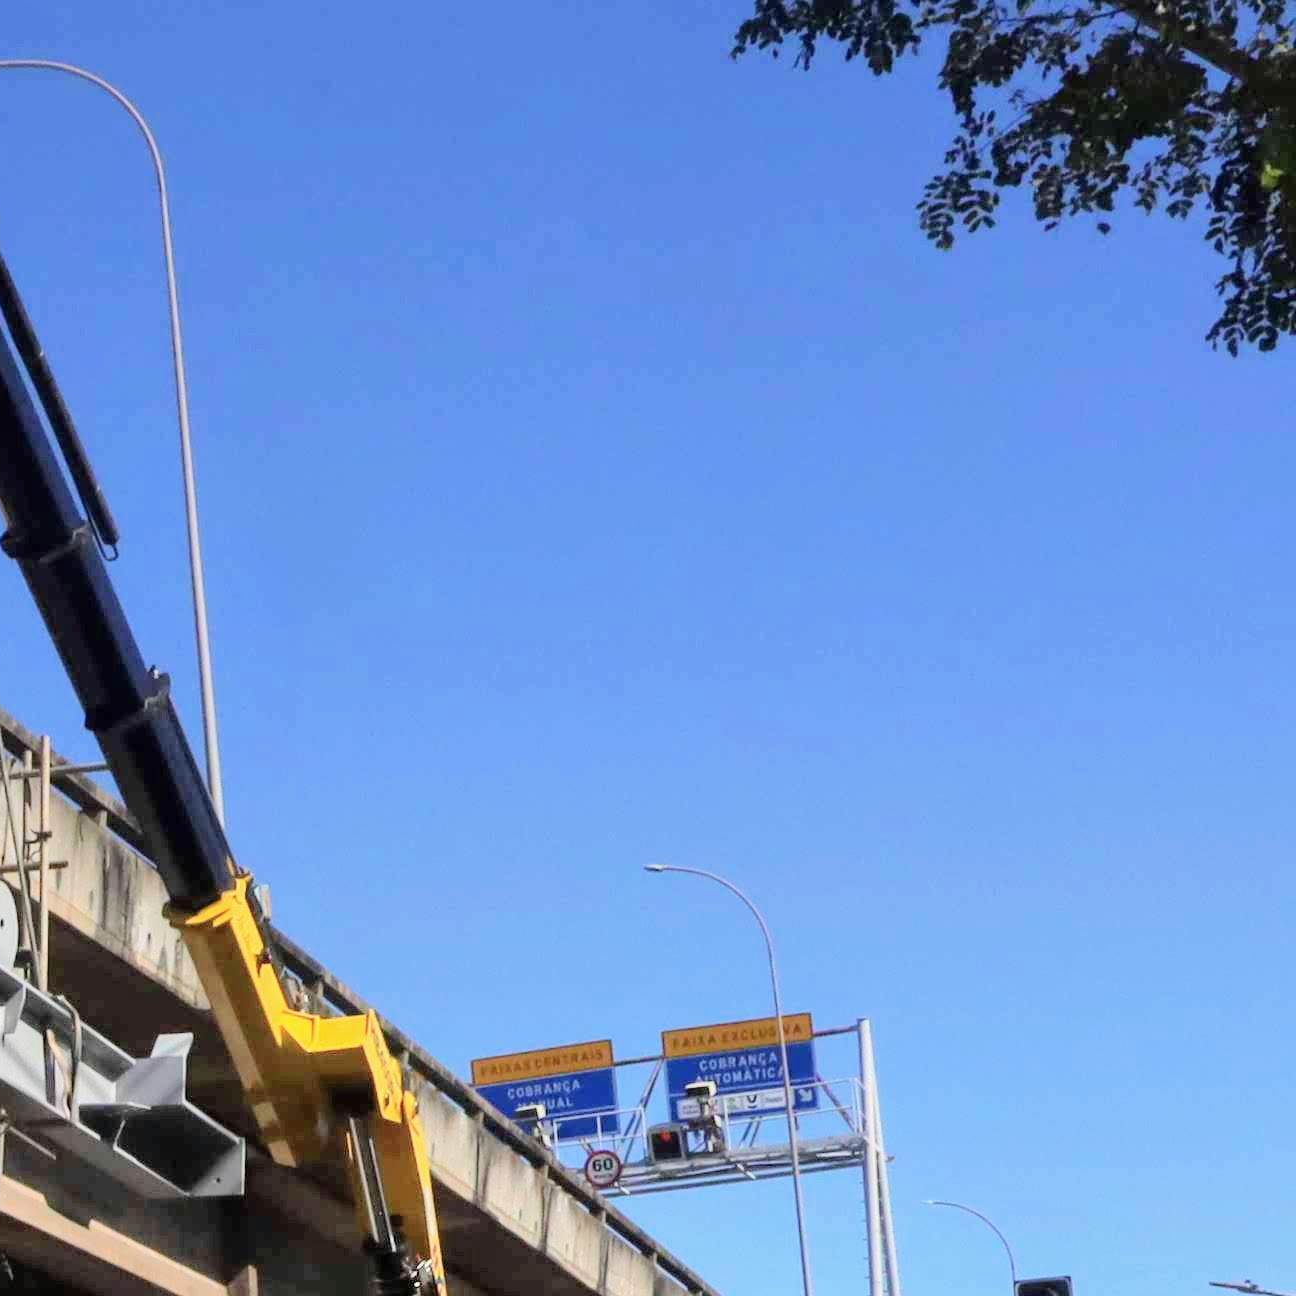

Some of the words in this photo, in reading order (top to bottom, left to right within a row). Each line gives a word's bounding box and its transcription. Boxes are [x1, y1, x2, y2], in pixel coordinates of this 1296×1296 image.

[671, 1033, 718, 1050] FAIXA
[721, 1023, 802, 1044] EXCLUSVA
[534, 1048, 604, 1069] CENTRAIS
[698, 1051, 778, 1072] COBRANÇA
[507, 1079, 581, 1100] COBRANÇA
[592, 1158, 614, 1172] 60
